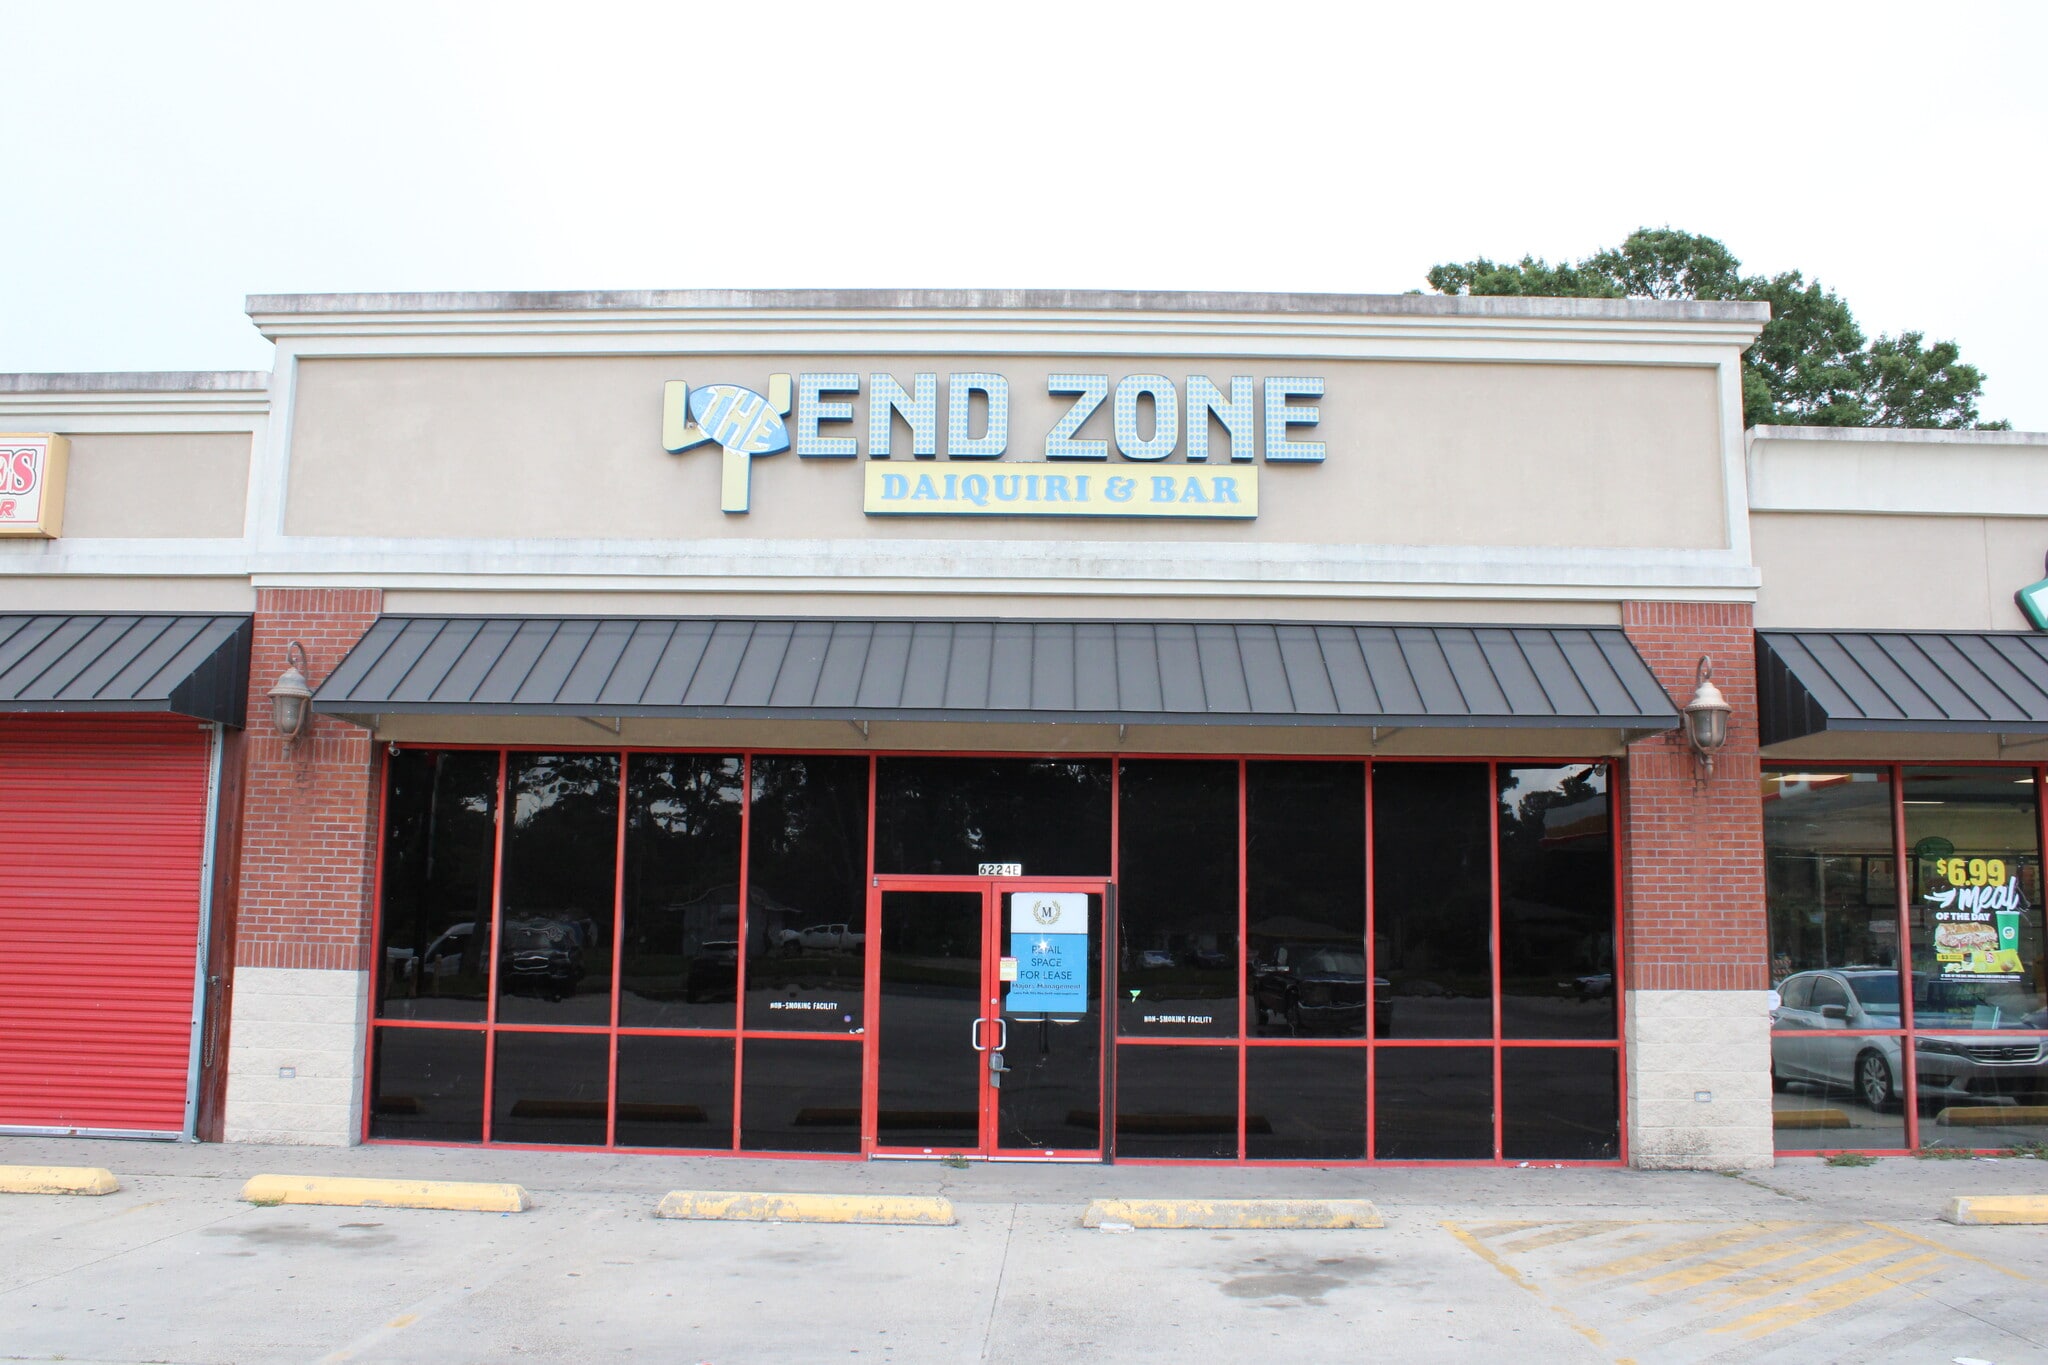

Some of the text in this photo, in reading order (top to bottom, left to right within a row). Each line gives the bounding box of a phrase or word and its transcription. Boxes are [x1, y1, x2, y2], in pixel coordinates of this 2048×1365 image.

[700, 386, 783, 451] THE
[796, 372, 1327, 462] END ZONE
[880, 471, 1242, 507] DAIQUIRI & BAR
[979, 864, 1020, 876] 6224E
[1936, 858, 2006, 887] $6.99
[1958, 875, 2019, 915] meal
[1041, 906, 1053, 918] M
[1935, 912, 1991, 921] OF THE DAY
[1031, 958, 1062, 967] SPACE
[1020, 970, 1072, 980] FOR LEASE
[812, 1002, 838, 1010] FACILITY
[1187, 1015, 1212, 1024] FACILITY
